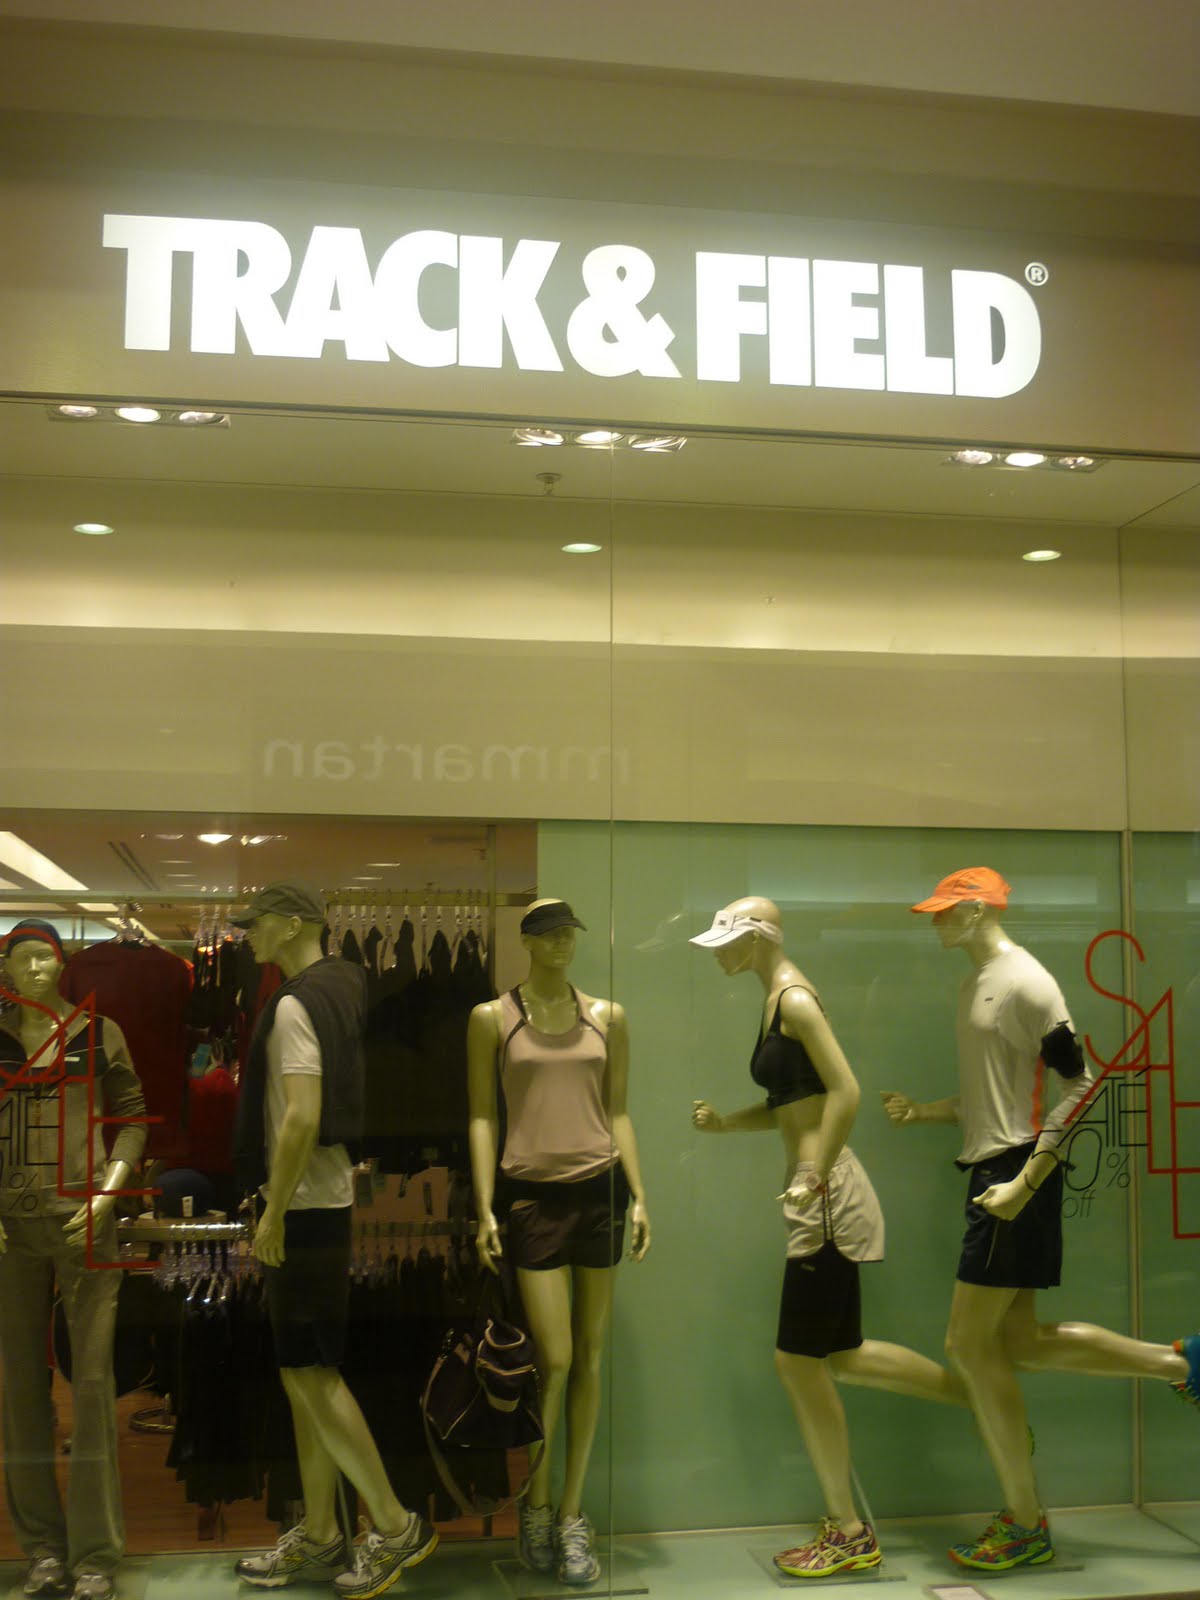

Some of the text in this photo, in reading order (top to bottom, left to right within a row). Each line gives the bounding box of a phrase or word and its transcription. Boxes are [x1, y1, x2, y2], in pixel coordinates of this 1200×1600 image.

[102, 213, 564, 372] TRACK
[566, 244, 682, 378] &
[695, 251, 1043, 399] FIELD
